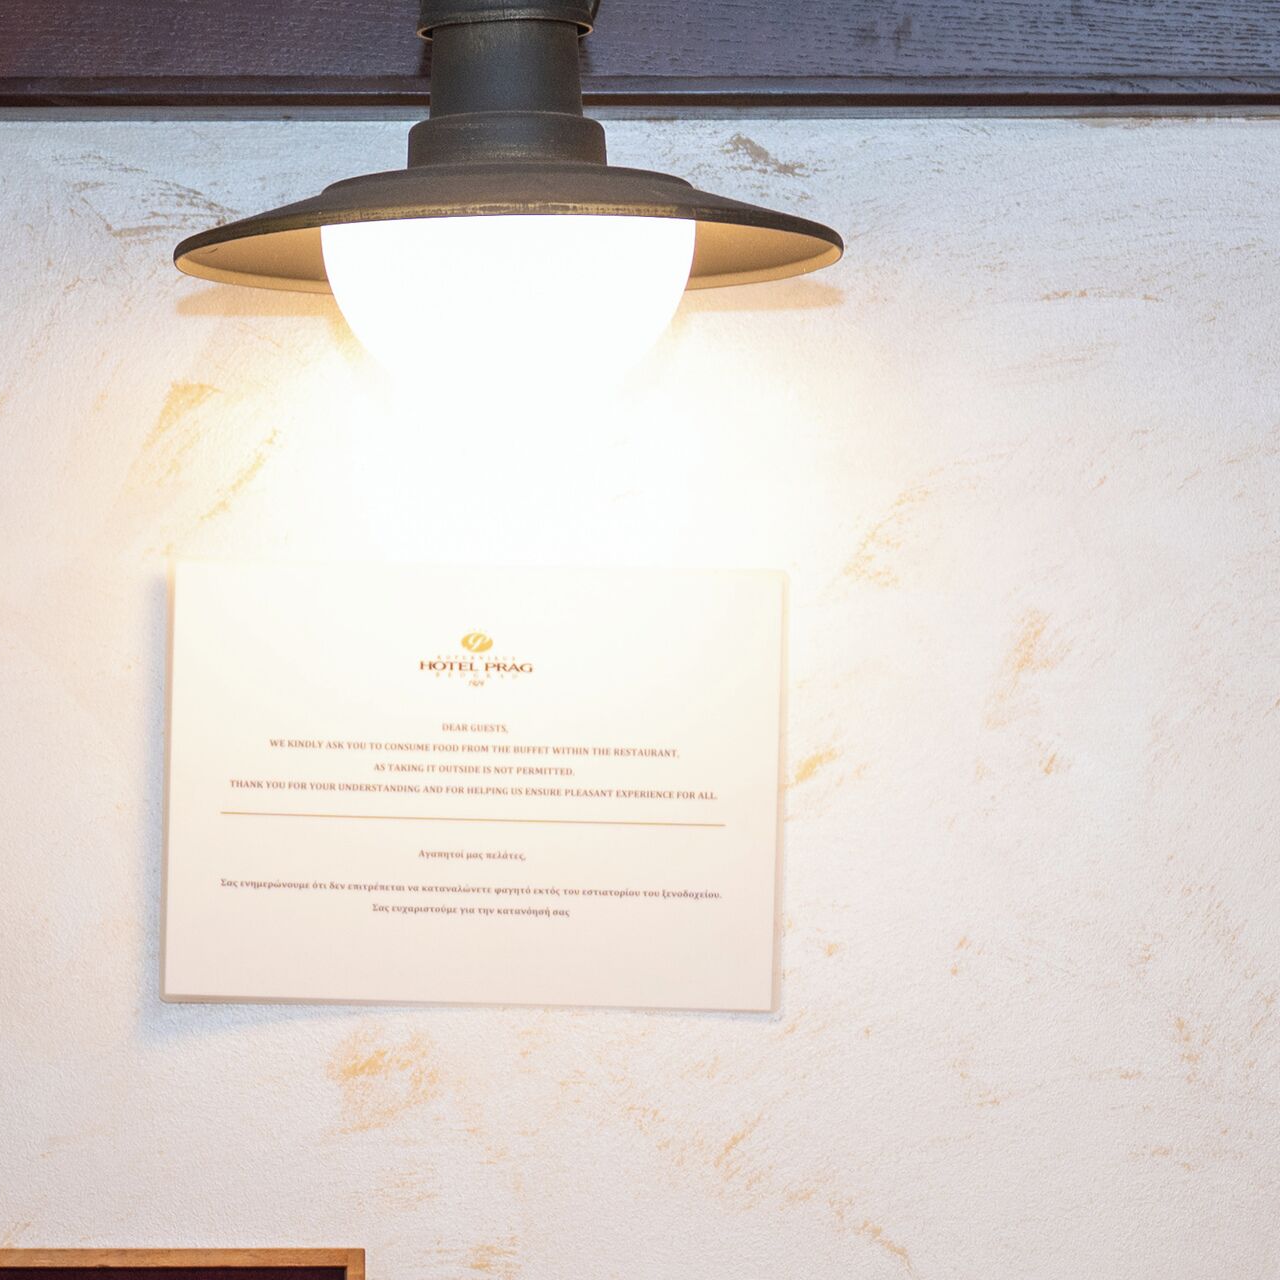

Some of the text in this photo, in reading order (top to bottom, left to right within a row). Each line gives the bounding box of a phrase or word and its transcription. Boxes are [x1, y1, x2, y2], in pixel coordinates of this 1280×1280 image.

[419, 660, 534, 673] HOTEL PRAG
[442, 723, 509, 734] DEAR GUESTS,
[269, 738, 285, 748] WE
[287, 739, 323, 749] KINDLY
[325, 740, 344, 750] ASK
[346, 741, 367, 750] YOU
[369, 742, 382, 751] TO
[384, 742, 430, 752] CONSUME
[433, 743, 459, 753] FOOD
[462, 744, 489, 753] FROM
[492, 745, 511, 754] THE
[513, 745, 549, 755] BUFFET
[552, 746, 589, 756] WITHIN
[592, 747, 611, 756] THE
[374, 763, 575, 777] AS TAKING IT OUTSIDE IS NOT PERMITTED.
[229, 779, 718, 801] THANK YOU FOR YOUR UNDERSTANDING AND FOR HELPING US ENSURE PLEASANT EXPERIENCE FOR ALL.
[466, 851, 484, 861] μας
[220, 878, 238, 888] Σας
[312, 879, 328, 890] ότι
[329, 880, 346, 890] δεν
[407, 884, 419, 893] να
[533, 886, 561, 897] εκτός
[563, 887, 580, 897] του
[643, 889, 660, 898] του
[372, 903, 390, 913] Σας
[460, 905, 476, 916] για
[477, 906, 495, 916] την
[552, 908, 570, 918] σας
